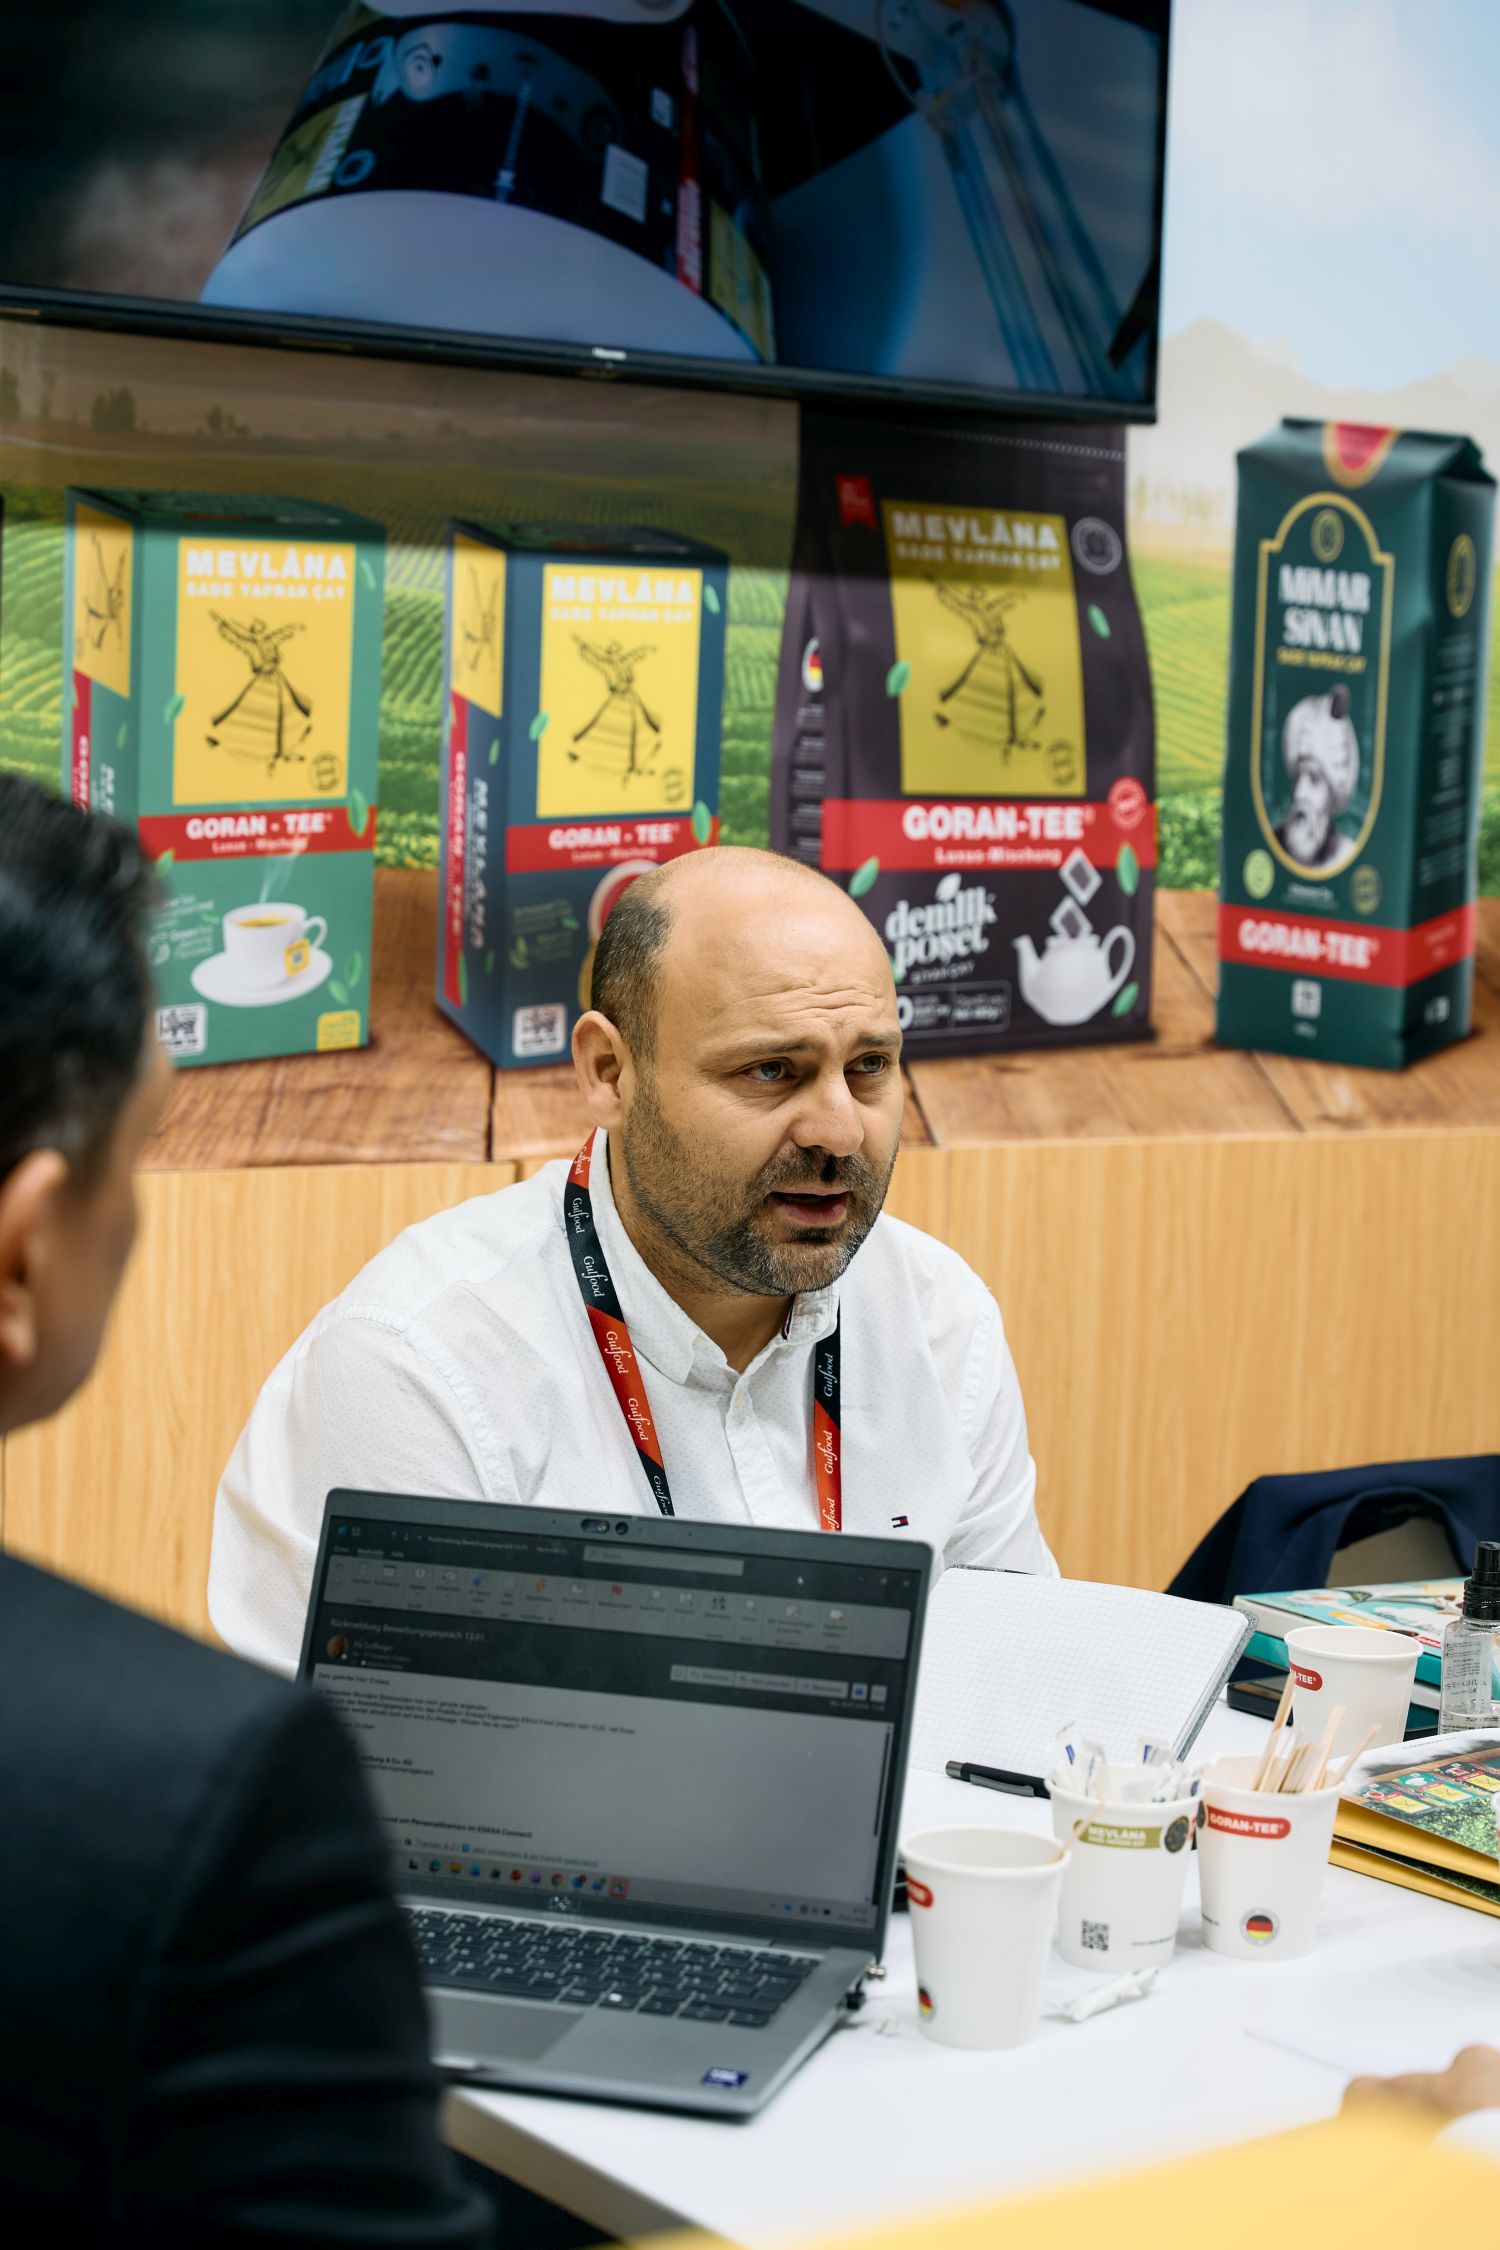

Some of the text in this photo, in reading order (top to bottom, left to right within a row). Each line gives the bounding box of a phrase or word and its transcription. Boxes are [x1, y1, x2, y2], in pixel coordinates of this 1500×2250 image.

[186, 815, 267, 840] GORAN
[548, 826, 621, 850] GORAN
[567, 1197, 590, 1234] Gulfood
[581, 1255, 608, 1297] Gulfood
[605, 1330, 632, 1374] Gulfood
[817, 1353, 838, 1397] Gulfood
[628, 1397, 651, 1441] Gulfood
[817, 1431, 838, 1475] Gulfood
